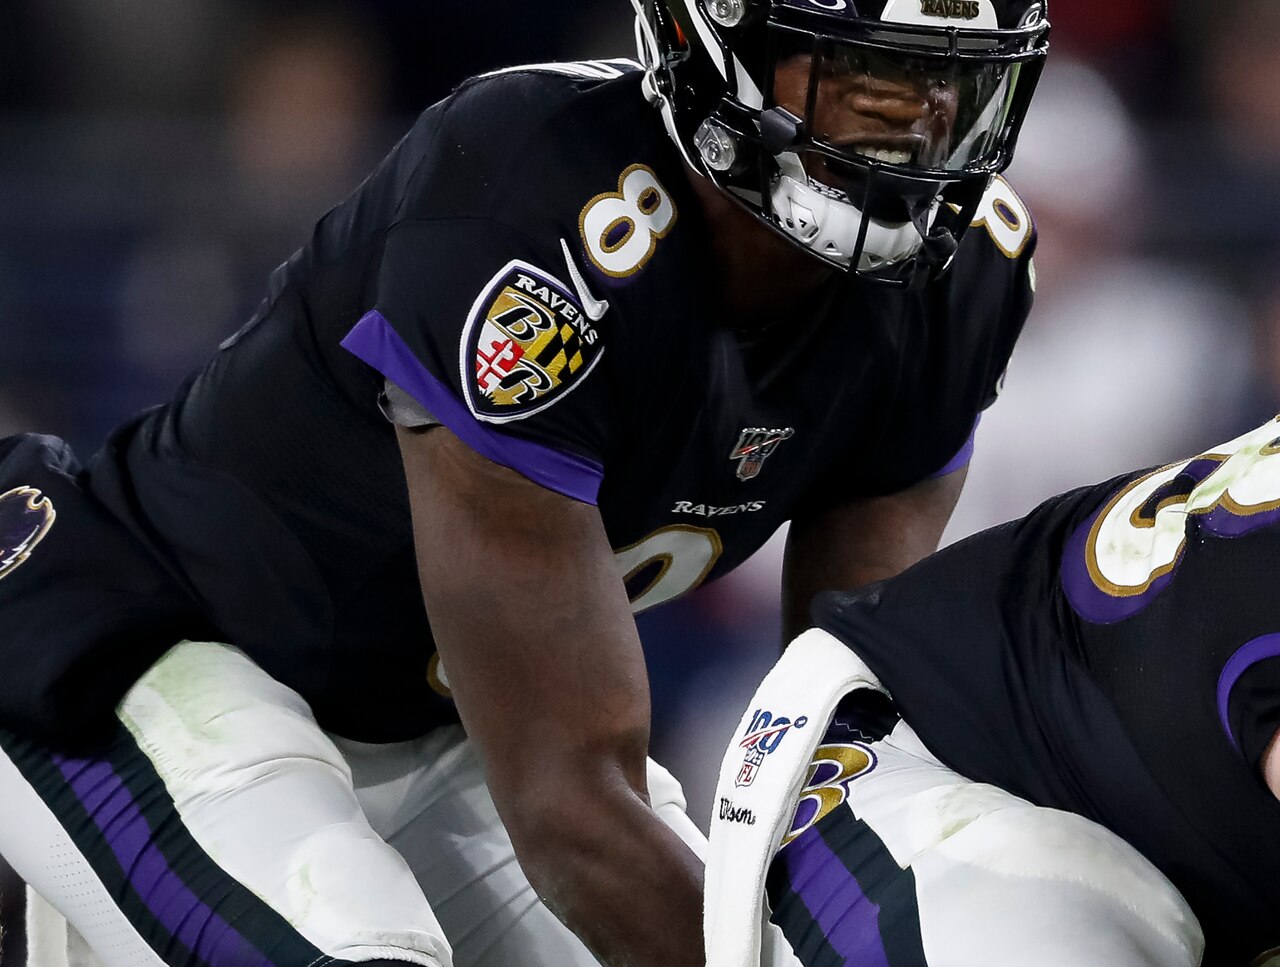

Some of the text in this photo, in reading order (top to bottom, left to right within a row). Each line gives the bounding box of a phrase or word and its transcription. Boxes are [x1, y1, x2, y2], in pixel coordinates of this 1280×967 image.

[579, 162, 678, 278] 8
[514, 274, 599, 345] RAVENS
[671, 501, 766, 517] RAVENS
